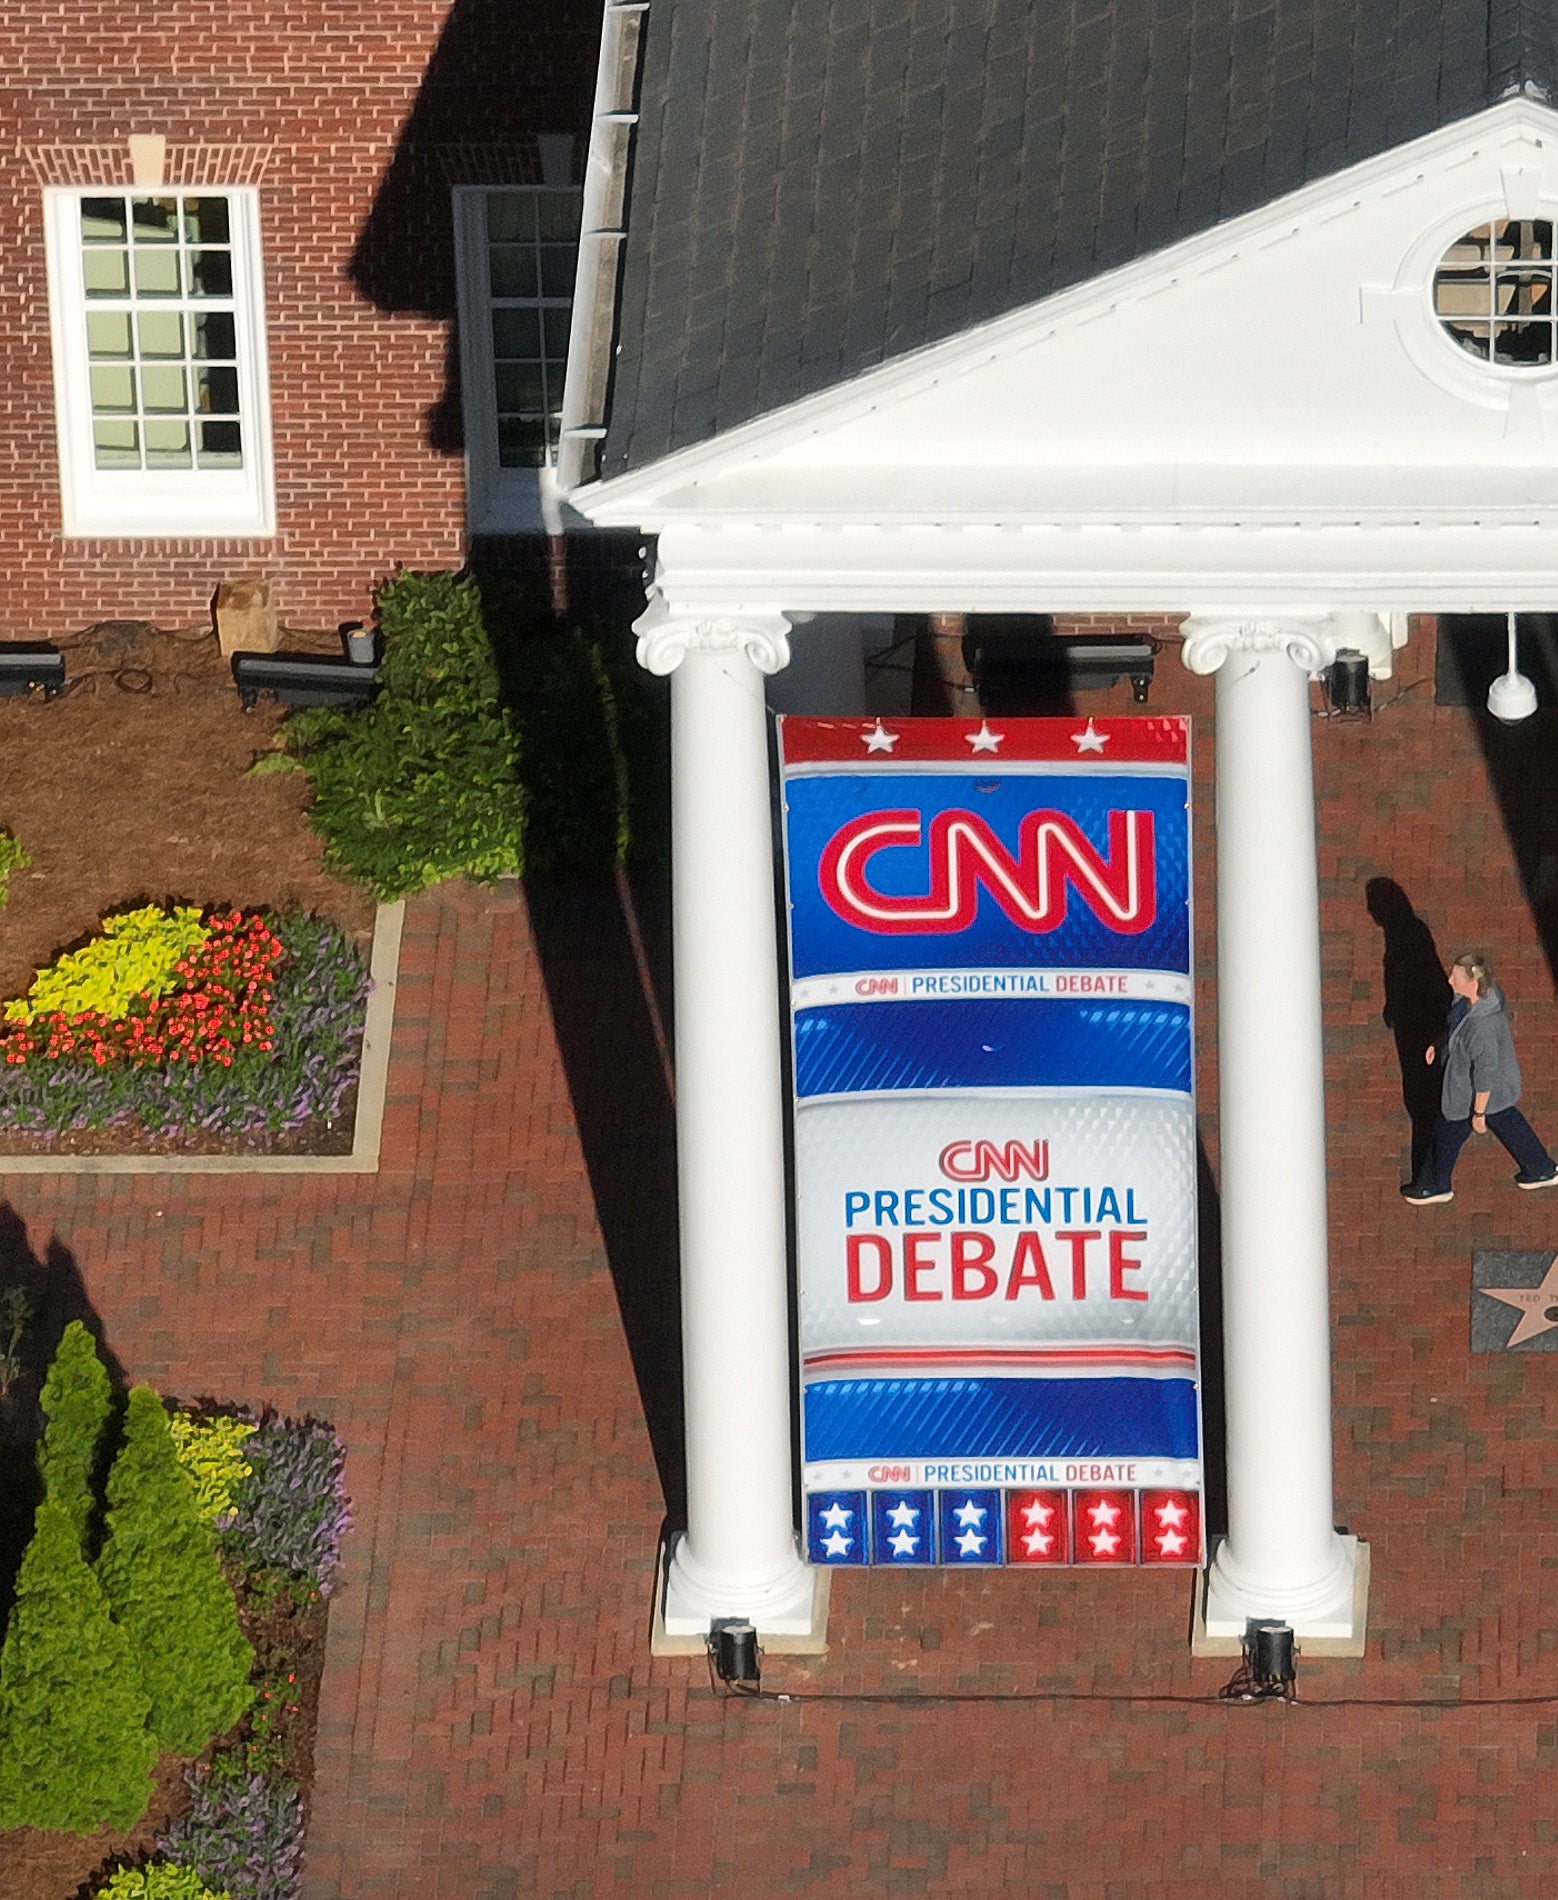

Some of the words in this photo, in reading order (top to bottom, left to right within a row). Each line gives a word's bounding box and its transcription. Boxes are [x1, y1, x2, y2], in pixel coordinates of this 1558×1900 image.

[818, 808, 1156, 935] CNN
[855, 977, 899, 995] CNN
[912, 976, 1050, 994] PRESIDENTIAL
[1055, 976, 1128, 993] DEBATE
[939, 1139, 1049, 1182] CNN
[845, 1187, 1148, 1228] PRESIDENTIAL
[846, 1230, 1149, 1303] DEBATE
[867, 1465, 911, 1482] CNN
[924, 1465, 1060, 1482] PRESIDENTIAL
[1065, 1465, 1137, 1482] DEBATE
